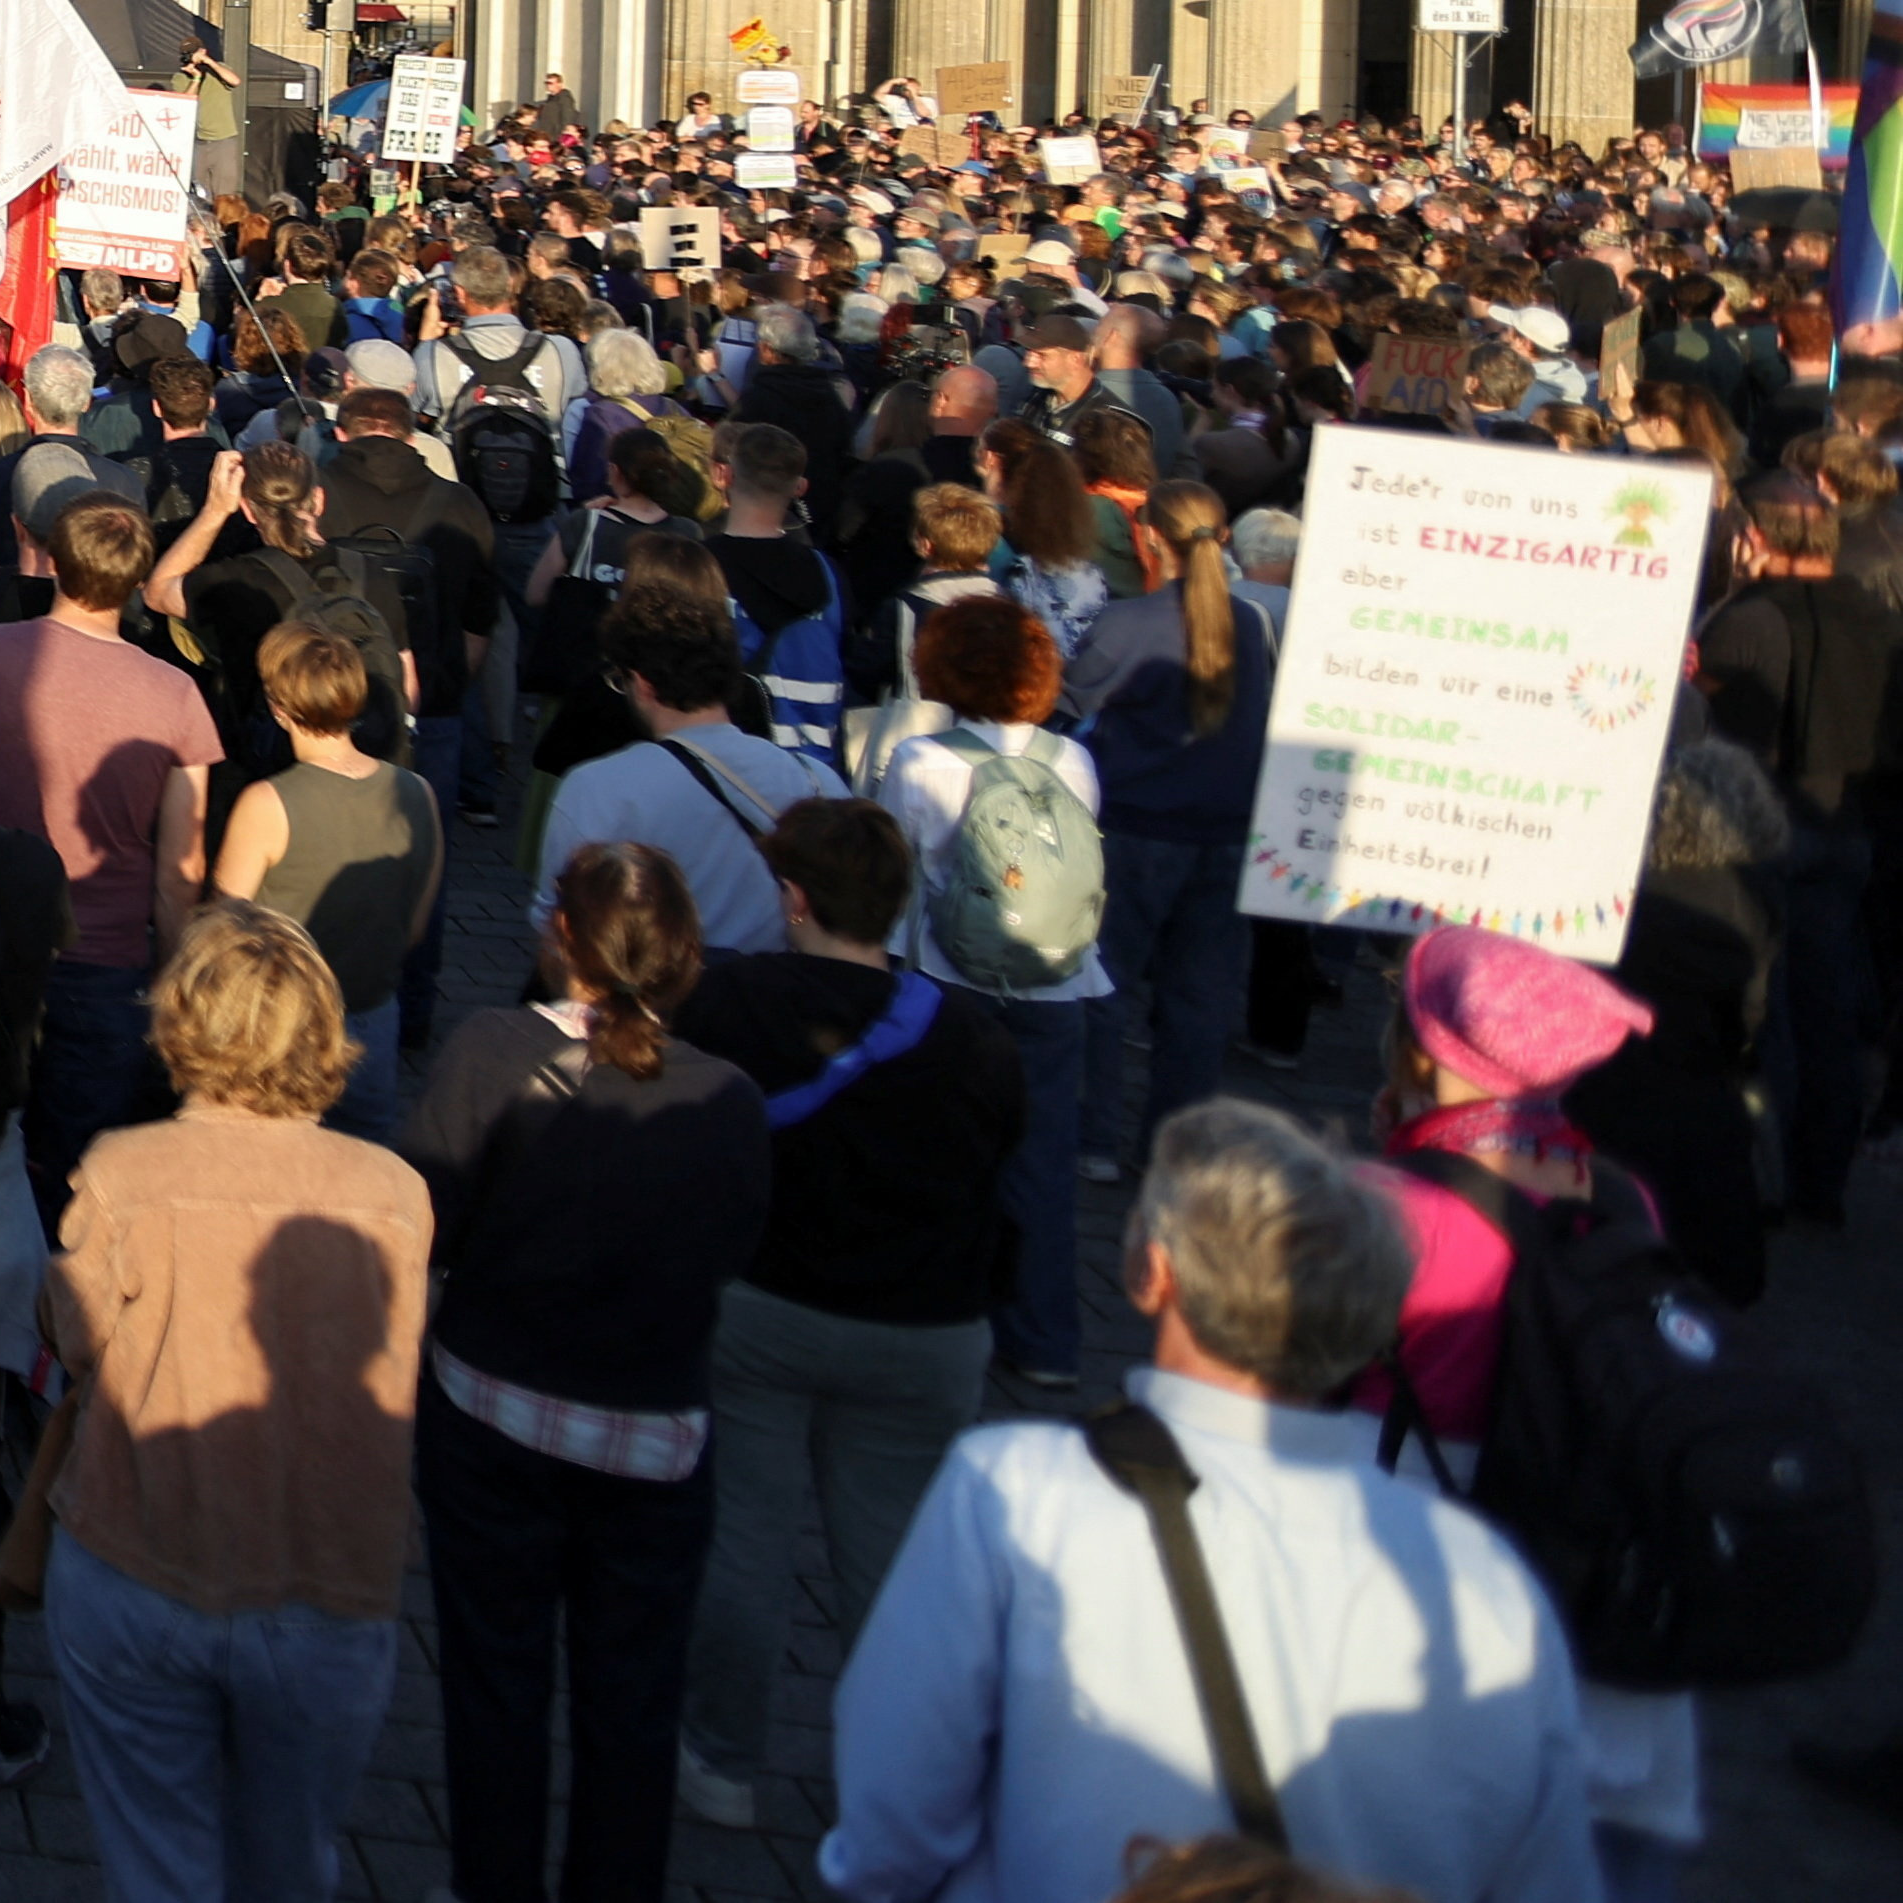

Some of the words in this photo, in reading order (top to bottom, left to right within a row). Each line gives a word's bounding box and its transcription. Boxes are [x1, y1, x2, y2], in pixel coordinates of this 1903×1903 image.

[1433, 11, 1449, 22] des
[127, 149, 182, 179] wählt
[104, 247, 176, 274] MLPD
[1384, 342, 1464, 380] FUCK
[1385, 376, 1449, 413] AfD
[1463, 489, 1511, 510] von
[1531, 498, 1579, 519] uns
[1359, 523, 1399, 546] ist
[1419, 526, 1669, 580] EINZIGARTIG
[1341, 563, 1408, 591] aber
[1349, 605, 1570, 654] GEMEINSAM
[1324, 652, 1419, 688] bilden
[1440, 674, 1482, 696] wir
[1496, 682, 1554, 708] eine
[1312, 748, 1604, 813] GEMEINSCHAFT
[1297, 784, 1385, 820] gegen
[1404, 798, 1553, 841] völkischen
[1297, 827, 1492, 880] Einheitsbrei!
